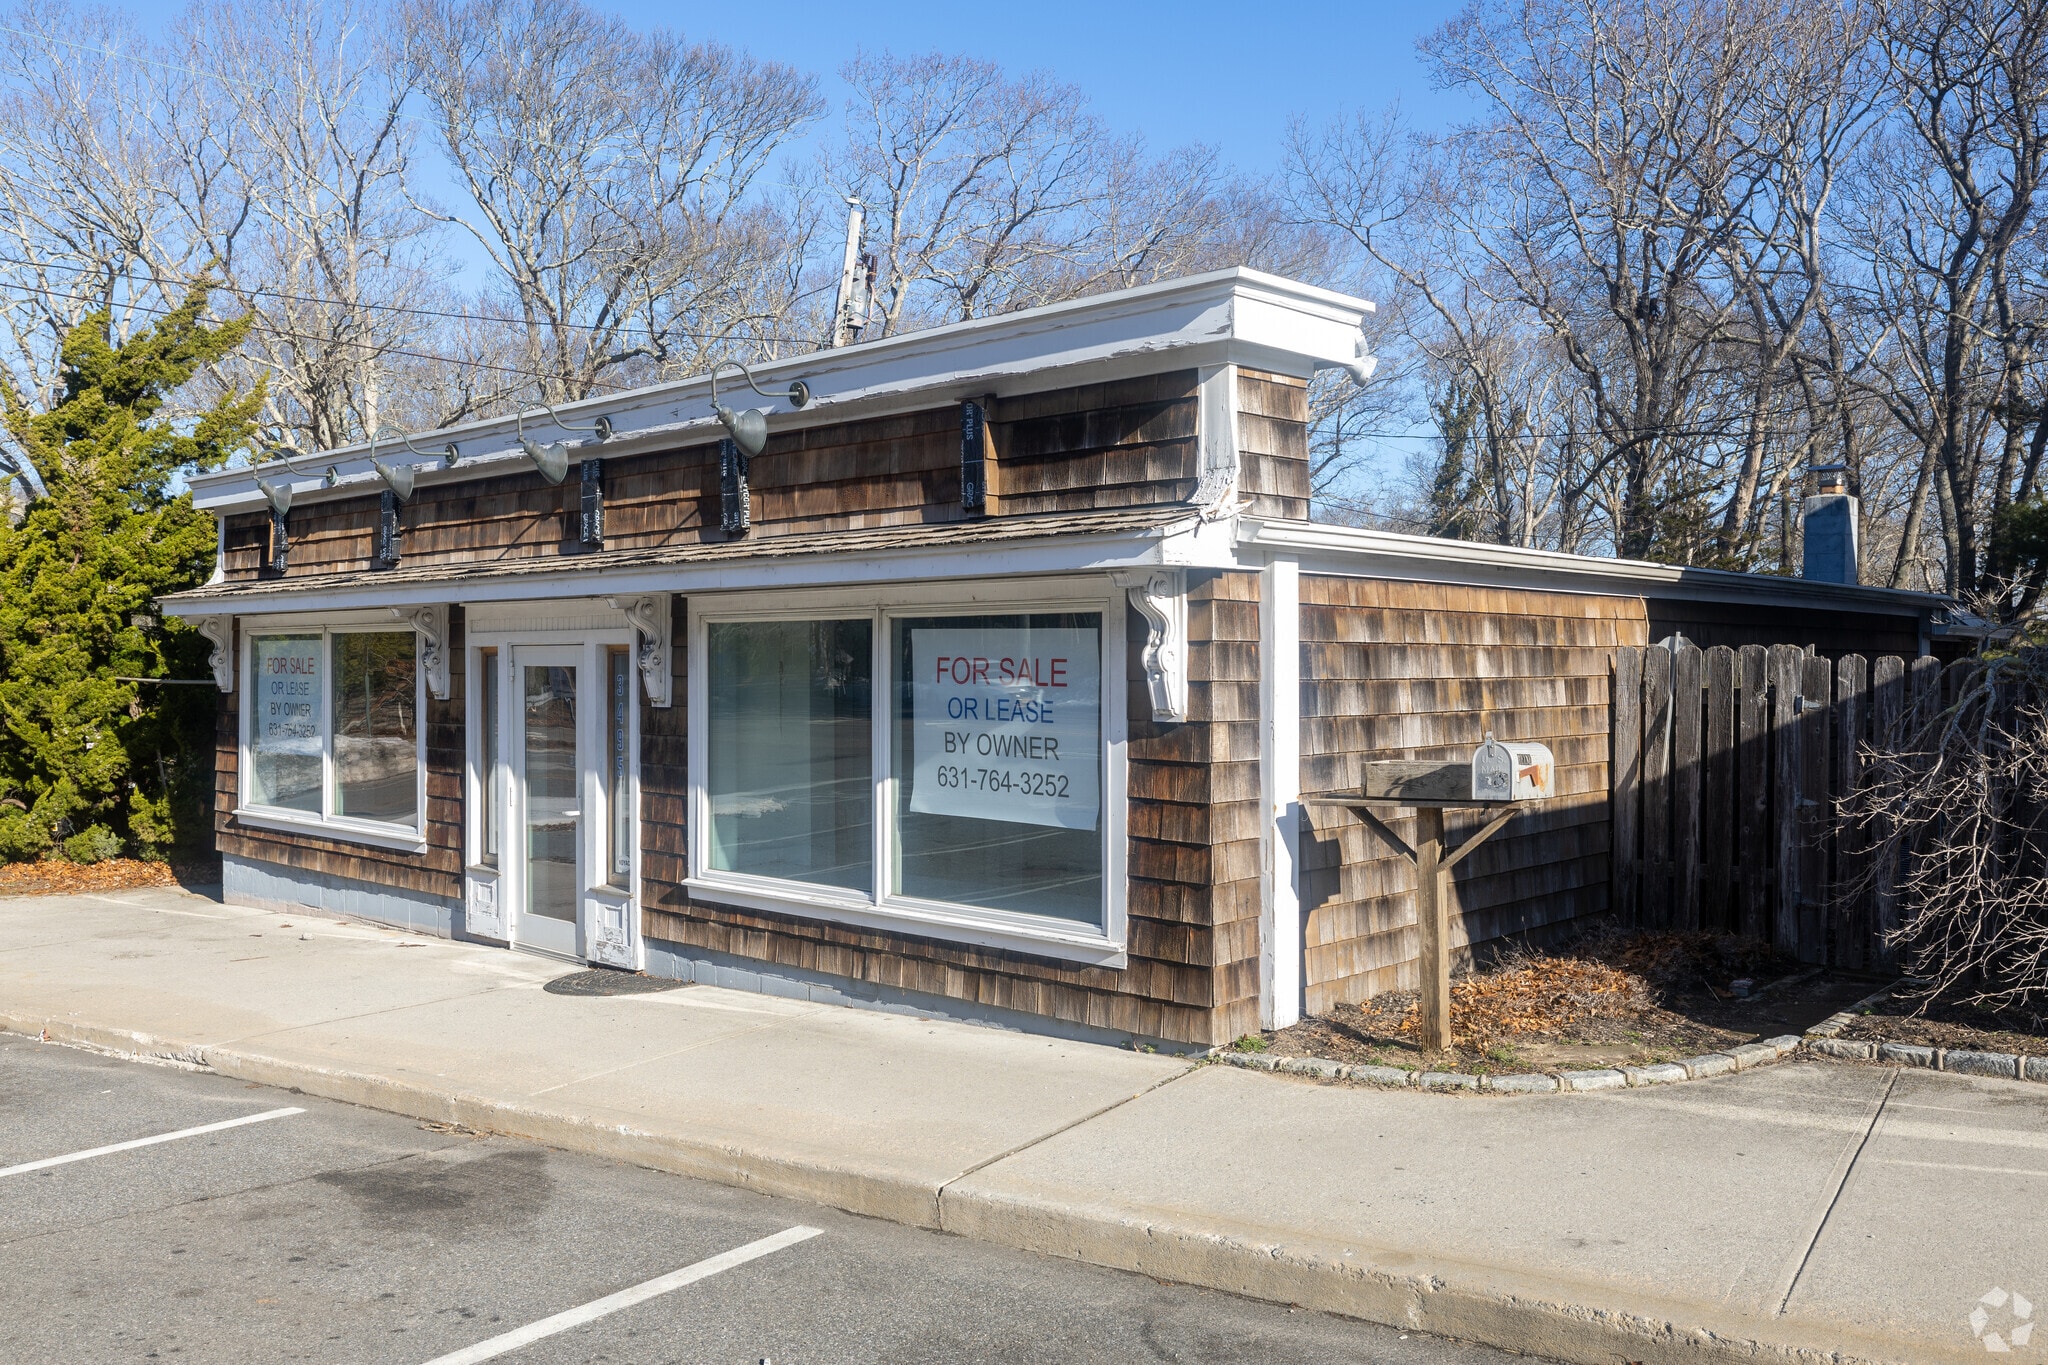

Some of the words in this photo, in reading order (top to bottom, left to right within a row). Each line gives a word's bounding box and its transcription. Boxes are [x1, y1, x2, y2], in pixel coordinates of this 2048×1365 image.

[966, 418, 974, 440] PLUS
[267, 657, 288, 674] FOR
[289, 657, 315, 675] SALE
[936, 656, 990, 686] FOR
[999, 657, 1069, 688] SALE
[271, 681, 285, 695] OR
[286, 681, 310, 696] LEASE
[270, 701, 282, 716] BY
[283, 702, 312, 718] OWNER
[947, 696, 979, 720] OR
[985, 698, 1055, 724] LEASE
[268, 722, 316, 739] 631-764-3252
[944, 731, 971, 754] BY
[976, 733, 1060, 761] OWNER
[937, 765, 1070, 798] 631-764-3252
